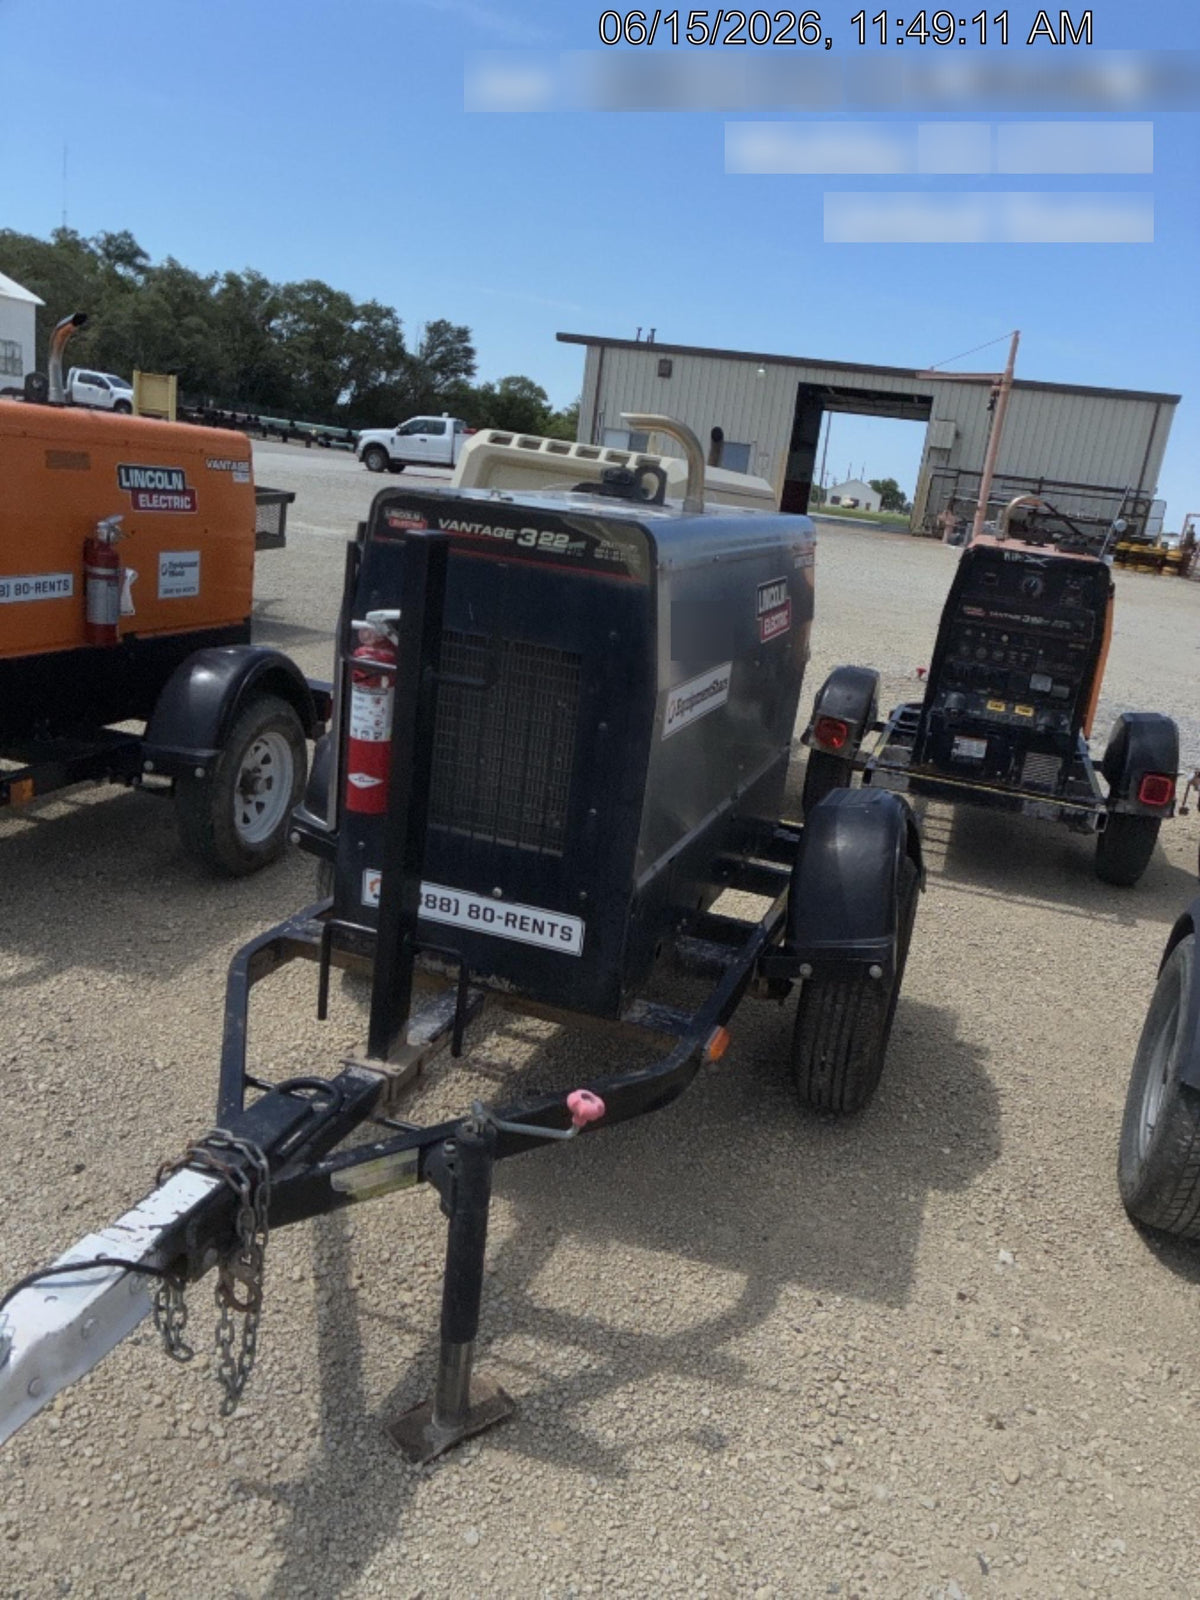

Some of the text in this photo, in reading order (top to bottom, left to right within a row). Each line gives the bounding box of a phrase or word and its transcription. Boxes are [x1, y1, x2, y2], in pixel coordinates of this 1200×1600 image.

[120, 467, 184, 490] LINCOLN
[138, 493, 192, 510] ELECTRIC
[438, 518, 517, 540] VANTAGE
[517, 527, 570, 550] 322
[14, 579, 70, 597] 80-RENTS
[758, 582, 787, 614] LINCOLN
[764, 609, 789, 636] ELECTRIC
[420, 892, 574, 943] 88) 80-RENTS
